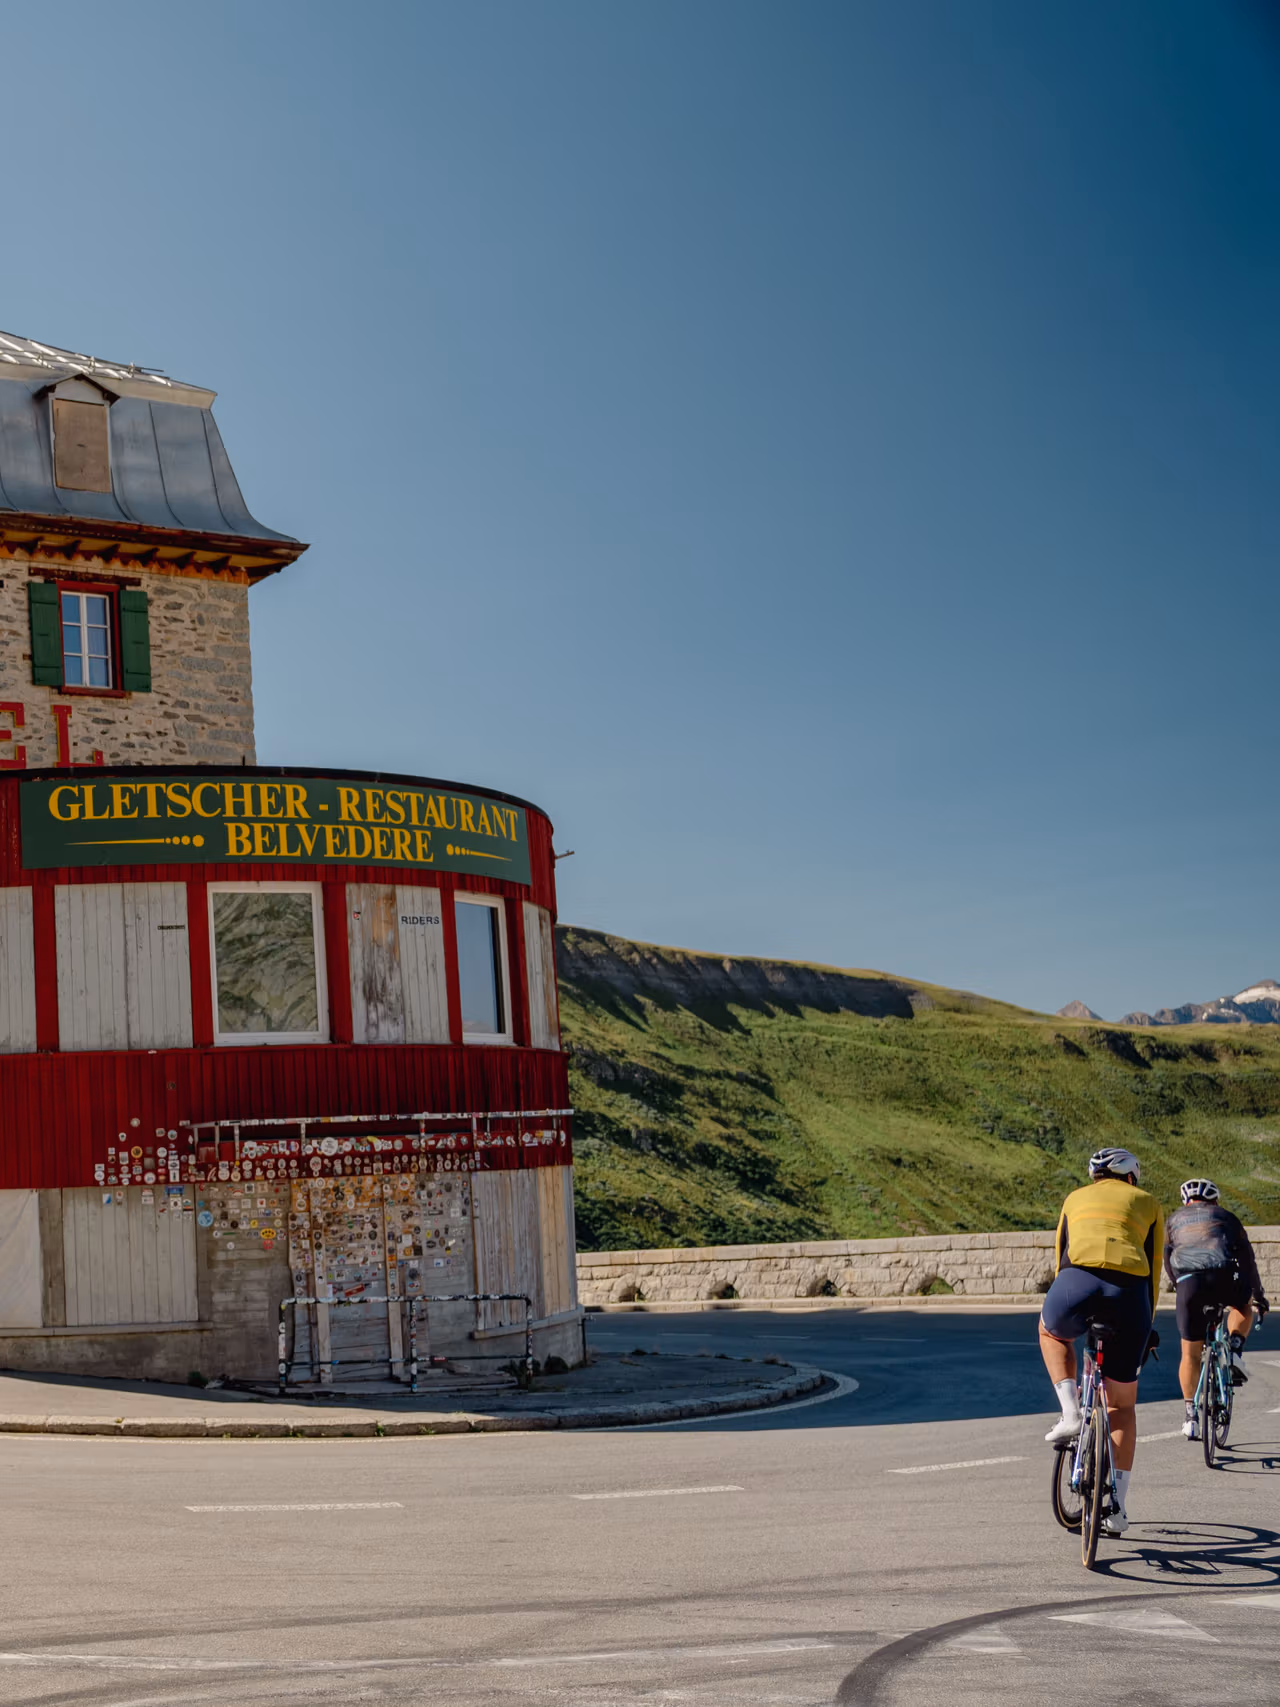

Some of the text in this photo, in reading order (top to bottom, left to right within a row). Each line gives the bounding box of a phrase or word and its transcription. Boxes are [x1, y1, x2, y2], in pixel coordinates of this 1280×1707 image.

[48, 782, 311, 821] GLETSCHER
[337, 786, 518, 842] RESTAURANT
[224, 822, 434, 863] BELVEDERE
[401, 915, 440, 925] RIDERS
